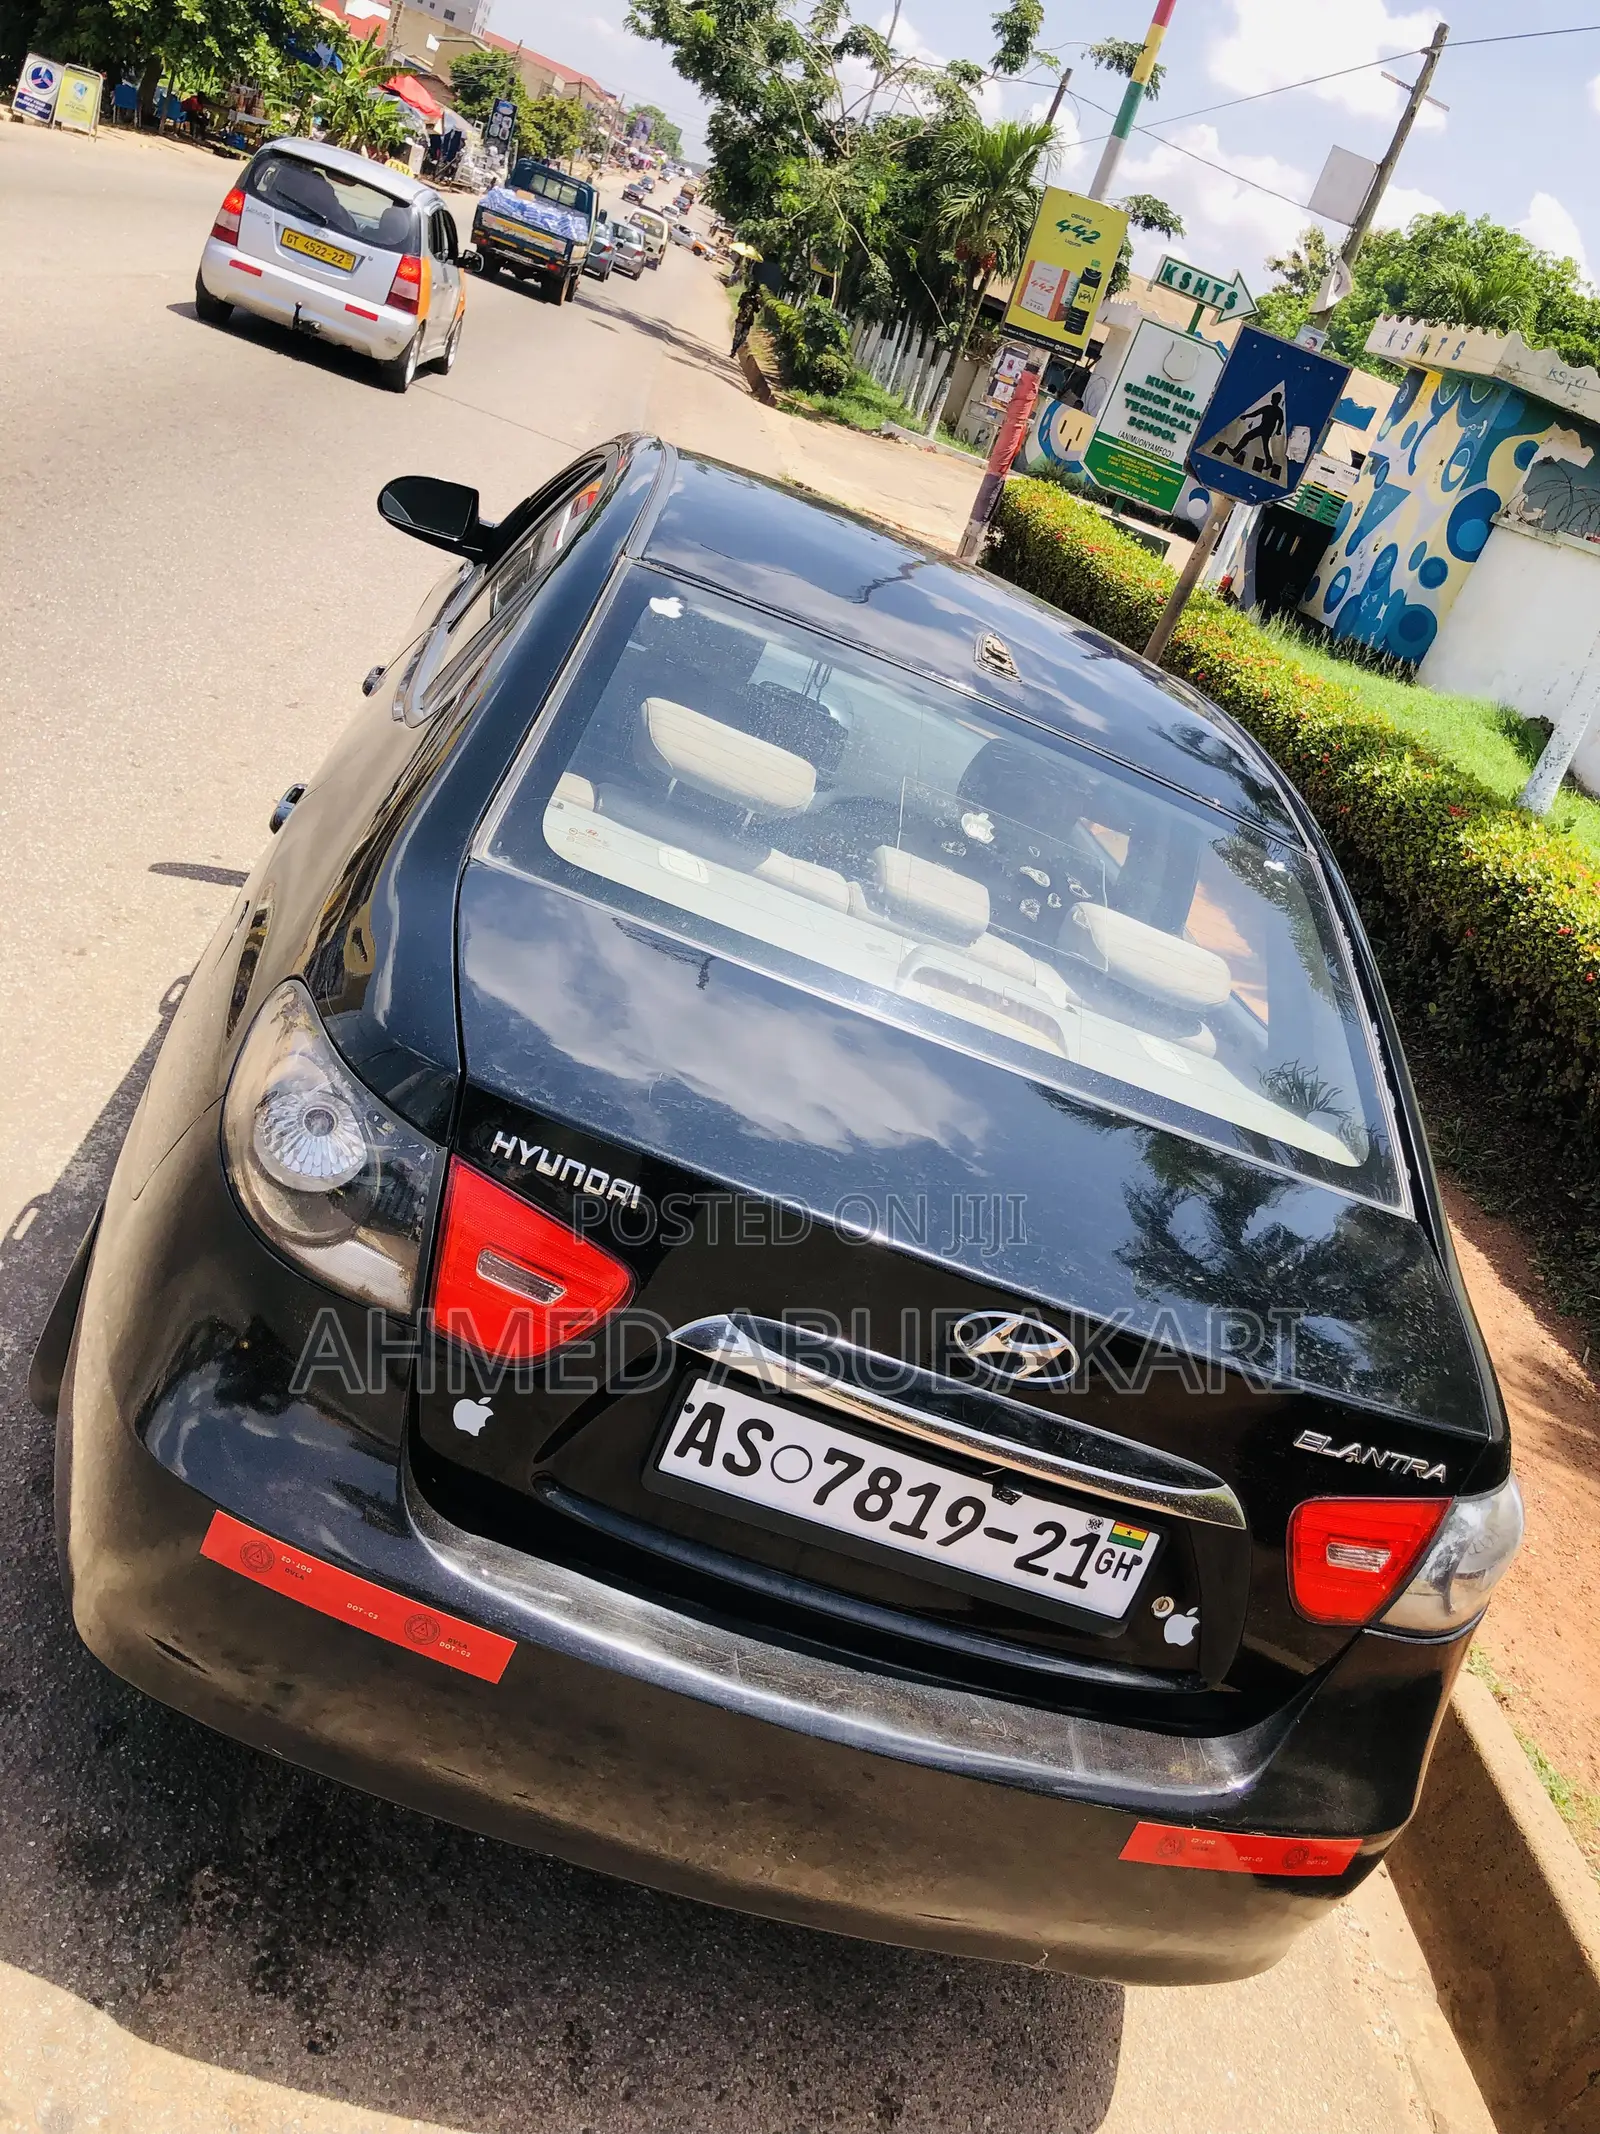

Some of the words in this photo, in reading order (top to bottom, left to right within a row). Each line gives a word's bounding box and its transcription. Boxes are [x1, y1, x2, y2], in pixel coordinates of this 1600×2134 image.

[388, 160, 410, 176] TAXI
[1055, 219, 1101, 245] 442
[286, 234, 299, 246] GT
[304, 240, 345, 264] 4522-22
[1161, 264, 1238, 310] KSHTS
[1385, 329, 1466, 361] KSHTS
[1124, 382, 1171, 409] SENIOR
[1145, 374, 1196, 402] KUMASI
[1125, 398, 1192, 434] TECHNICAL
[1127, 415, 1177, 443] SCHOOL
[489, 1130, 642, 1211] HYUNDAI
[1293, 1429, 1448, 1484] ELANTRA
[673, 1401, 774, 1478] AS
[813, 1447, 1100, 1590] 7819-21
[1094, 1547, 1135, 1583] GH
